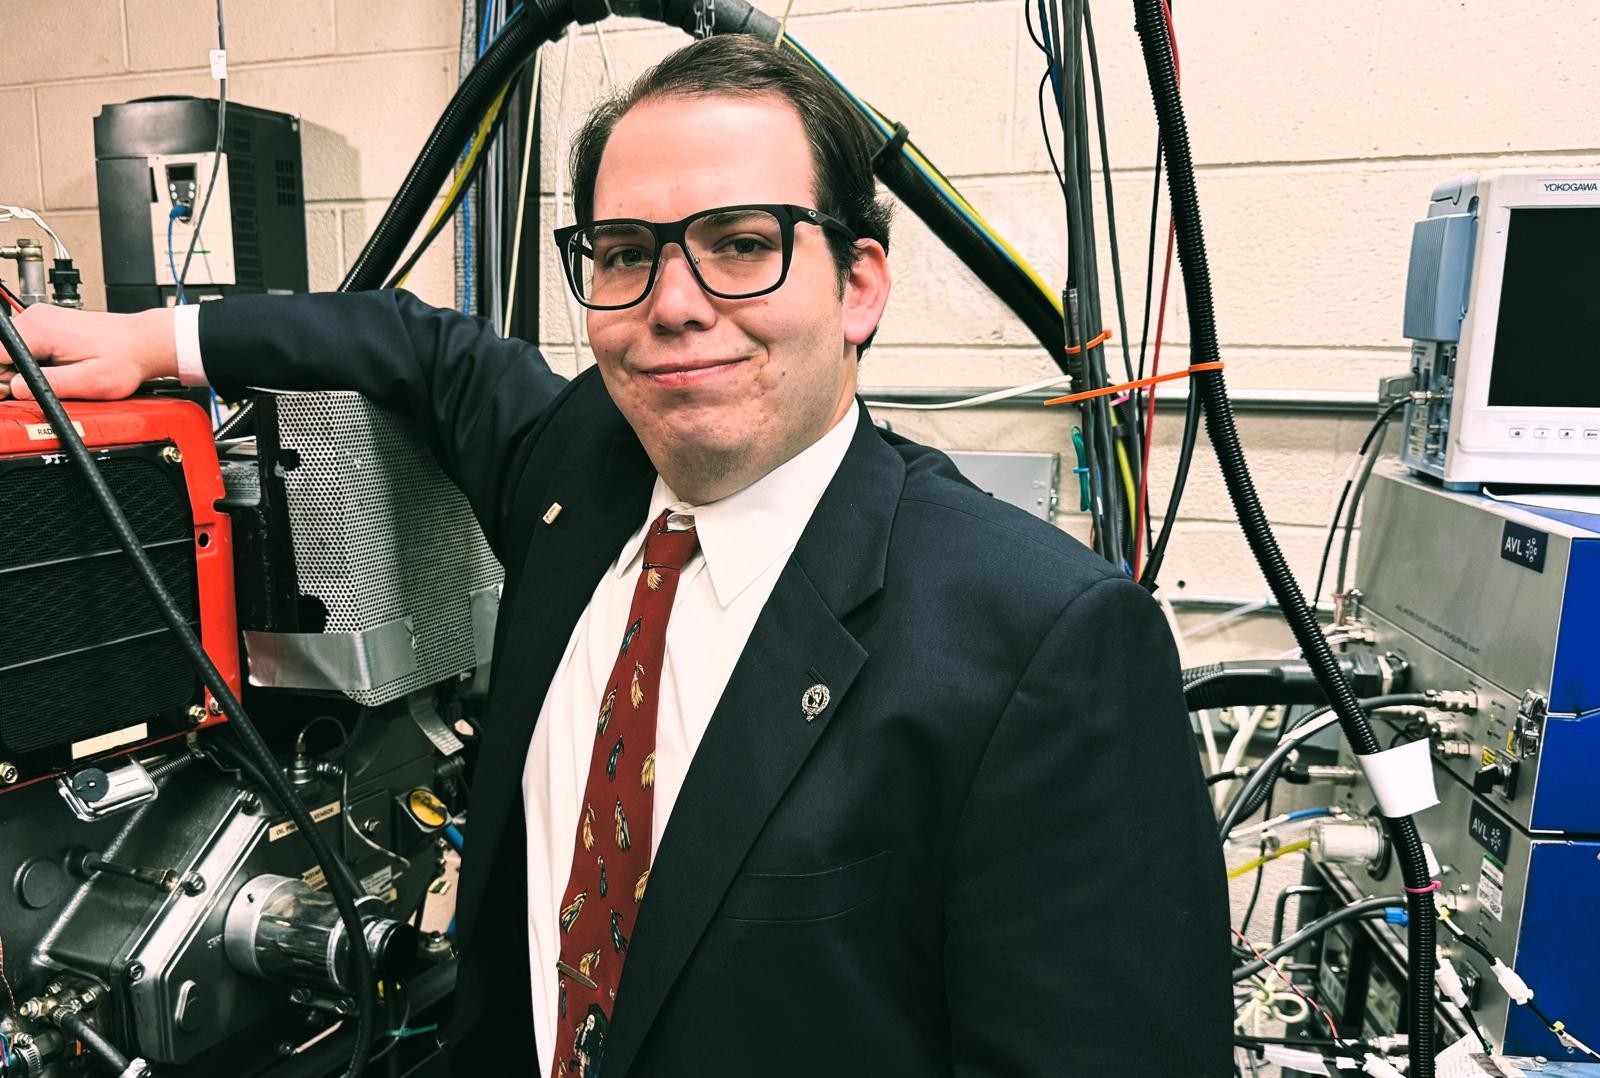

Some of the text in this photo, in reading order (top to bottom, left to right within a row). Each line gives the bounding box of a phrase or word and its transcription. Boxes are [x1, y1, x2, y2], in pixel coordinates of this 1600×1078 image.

[1544, 183, 1598, 192] YOKOGAWA
[1504, 535, 1523, 556] AVL
[1471, 817, 1488, 841] AVL
